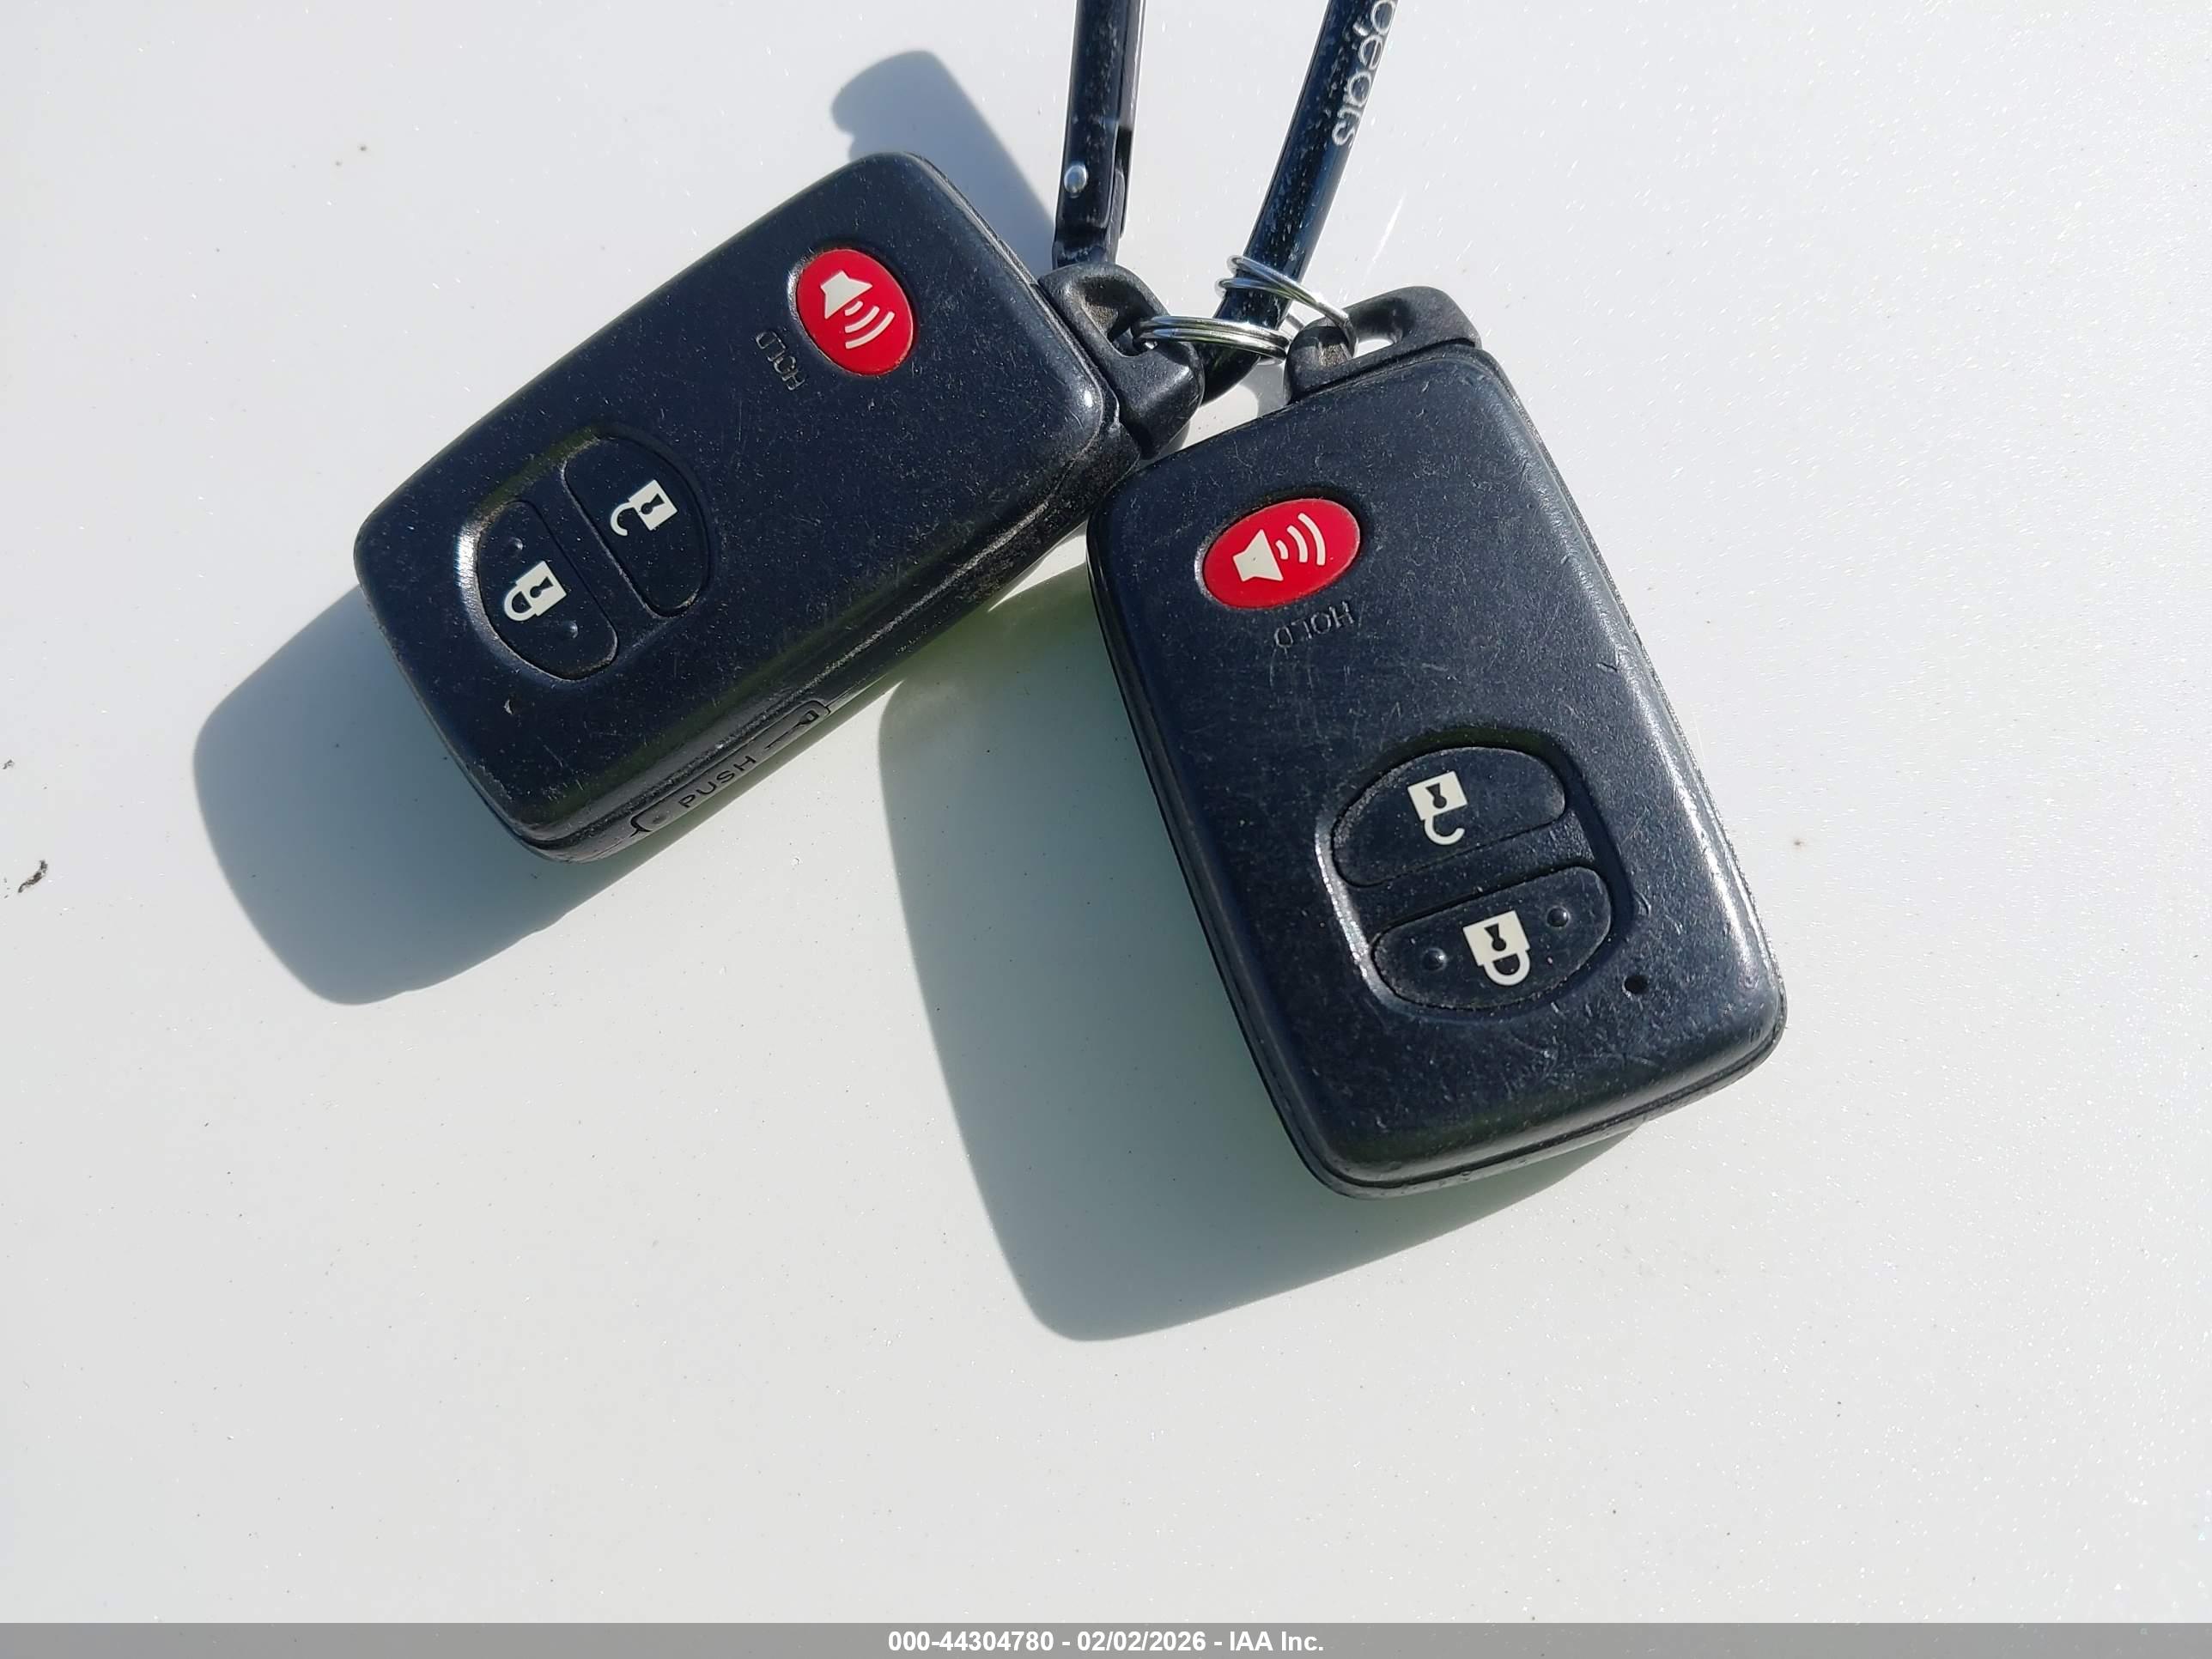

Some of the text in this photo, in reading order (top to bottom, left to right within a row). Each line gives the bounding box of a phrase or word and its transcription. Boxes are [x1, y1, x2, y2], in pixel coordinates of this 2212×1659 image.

[756, 331, 805, 391] HOLD
[1273, 601, 1355, 648] HOLD
[678, 755, 757, 808] PUSH
